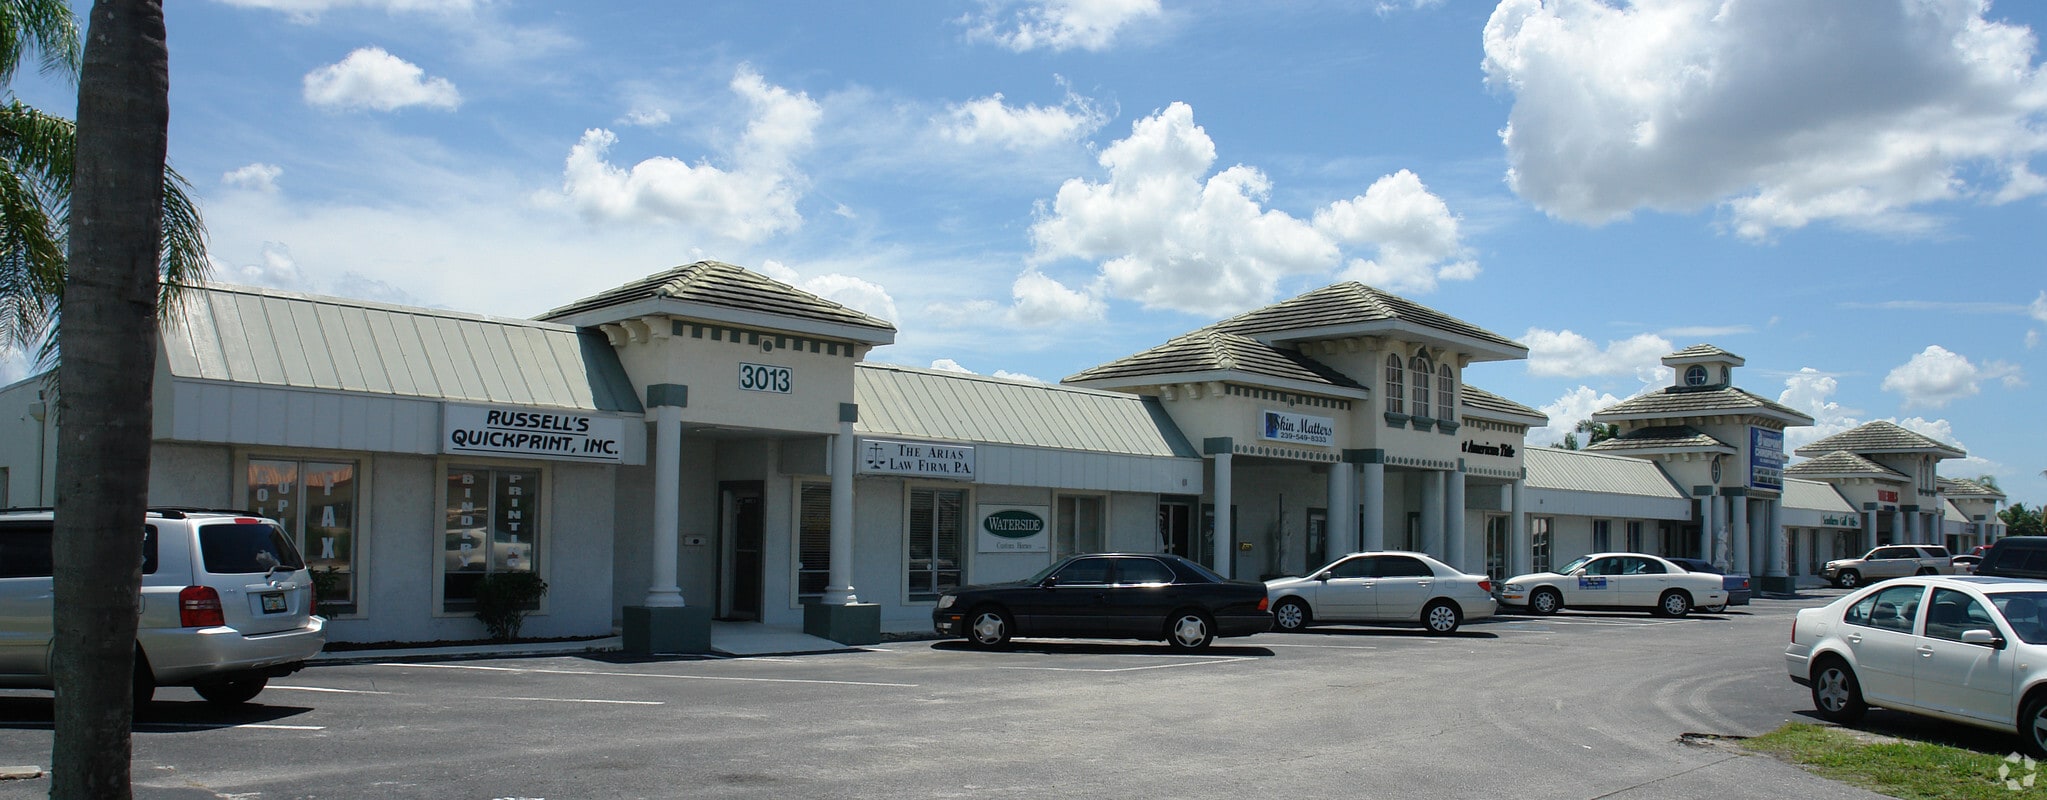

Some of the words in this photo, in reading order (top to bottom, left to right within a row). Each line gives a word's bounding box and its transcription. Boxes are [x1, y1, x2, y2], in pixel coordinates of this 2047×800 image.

[741, 365, 790, 392] 3013
[487, 410, 589, 432] RUSSELL'S
[1275, 414, 1294, 432] Skin
[1297, 418, 1333, 436] Matters
[452, 429, 577, 453] QUICKPRINT,
[583, 438, 619, 455] INC.
[898, 444, 921, 457] THE
[927, 447, 964, 459] ARIAS
[889, 458, 913, 470] LAW
[918, 460, 950, 474] FIRM,
[321, 471, 336, 559] FAX
[460, 474, 474, 567] BINDERY
[988, 516, 1041, 531] WATERSIDE
